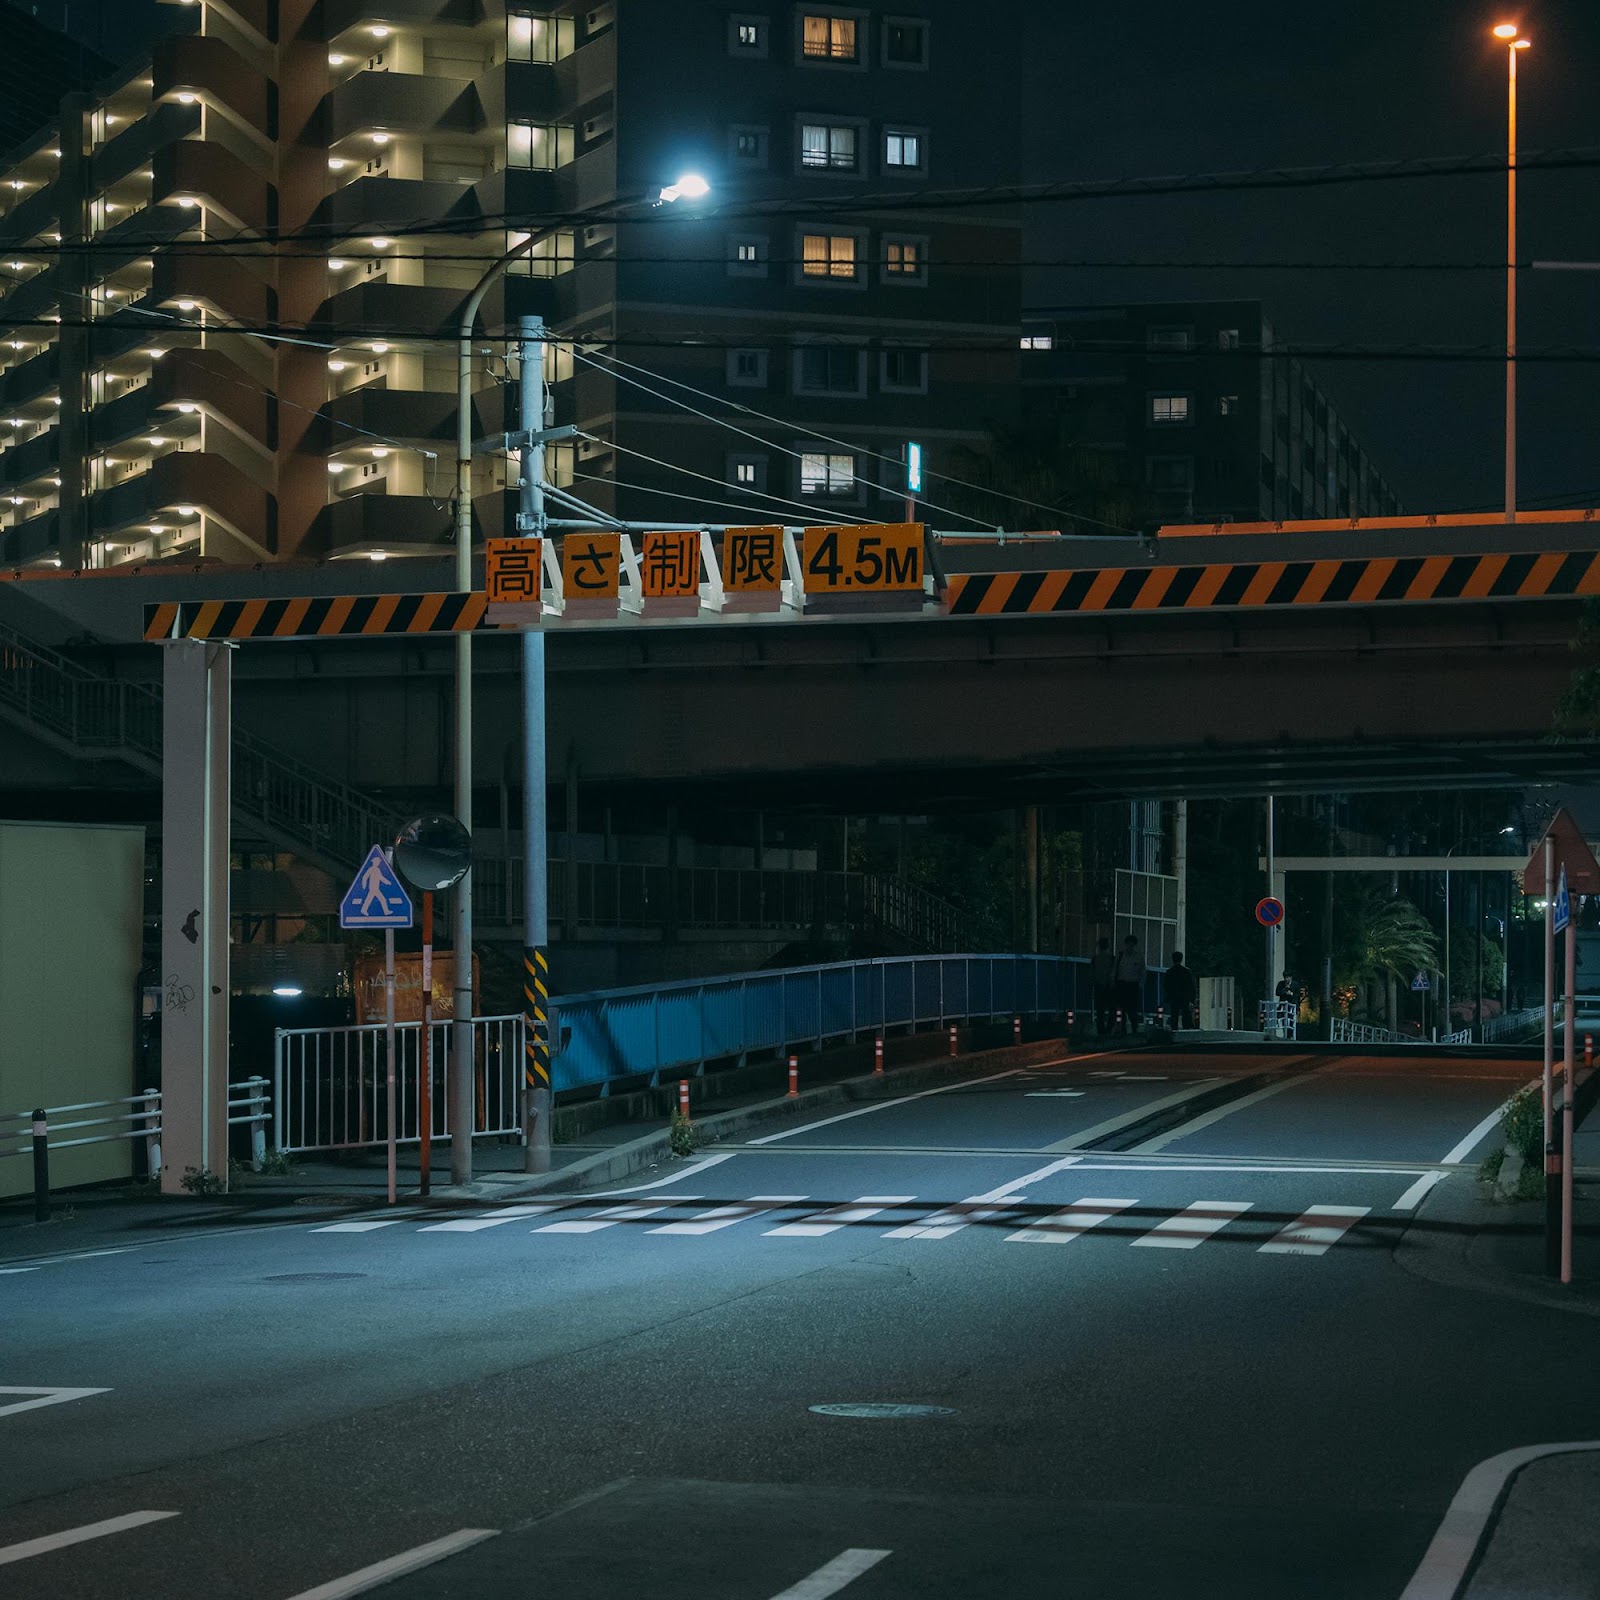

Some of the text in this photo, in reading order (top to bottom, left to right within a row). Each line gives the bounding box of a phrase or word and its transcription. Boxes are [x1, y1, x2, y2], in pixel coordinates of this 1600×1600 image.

[492, 532, 918, 598] 高さ制限 4.5M
